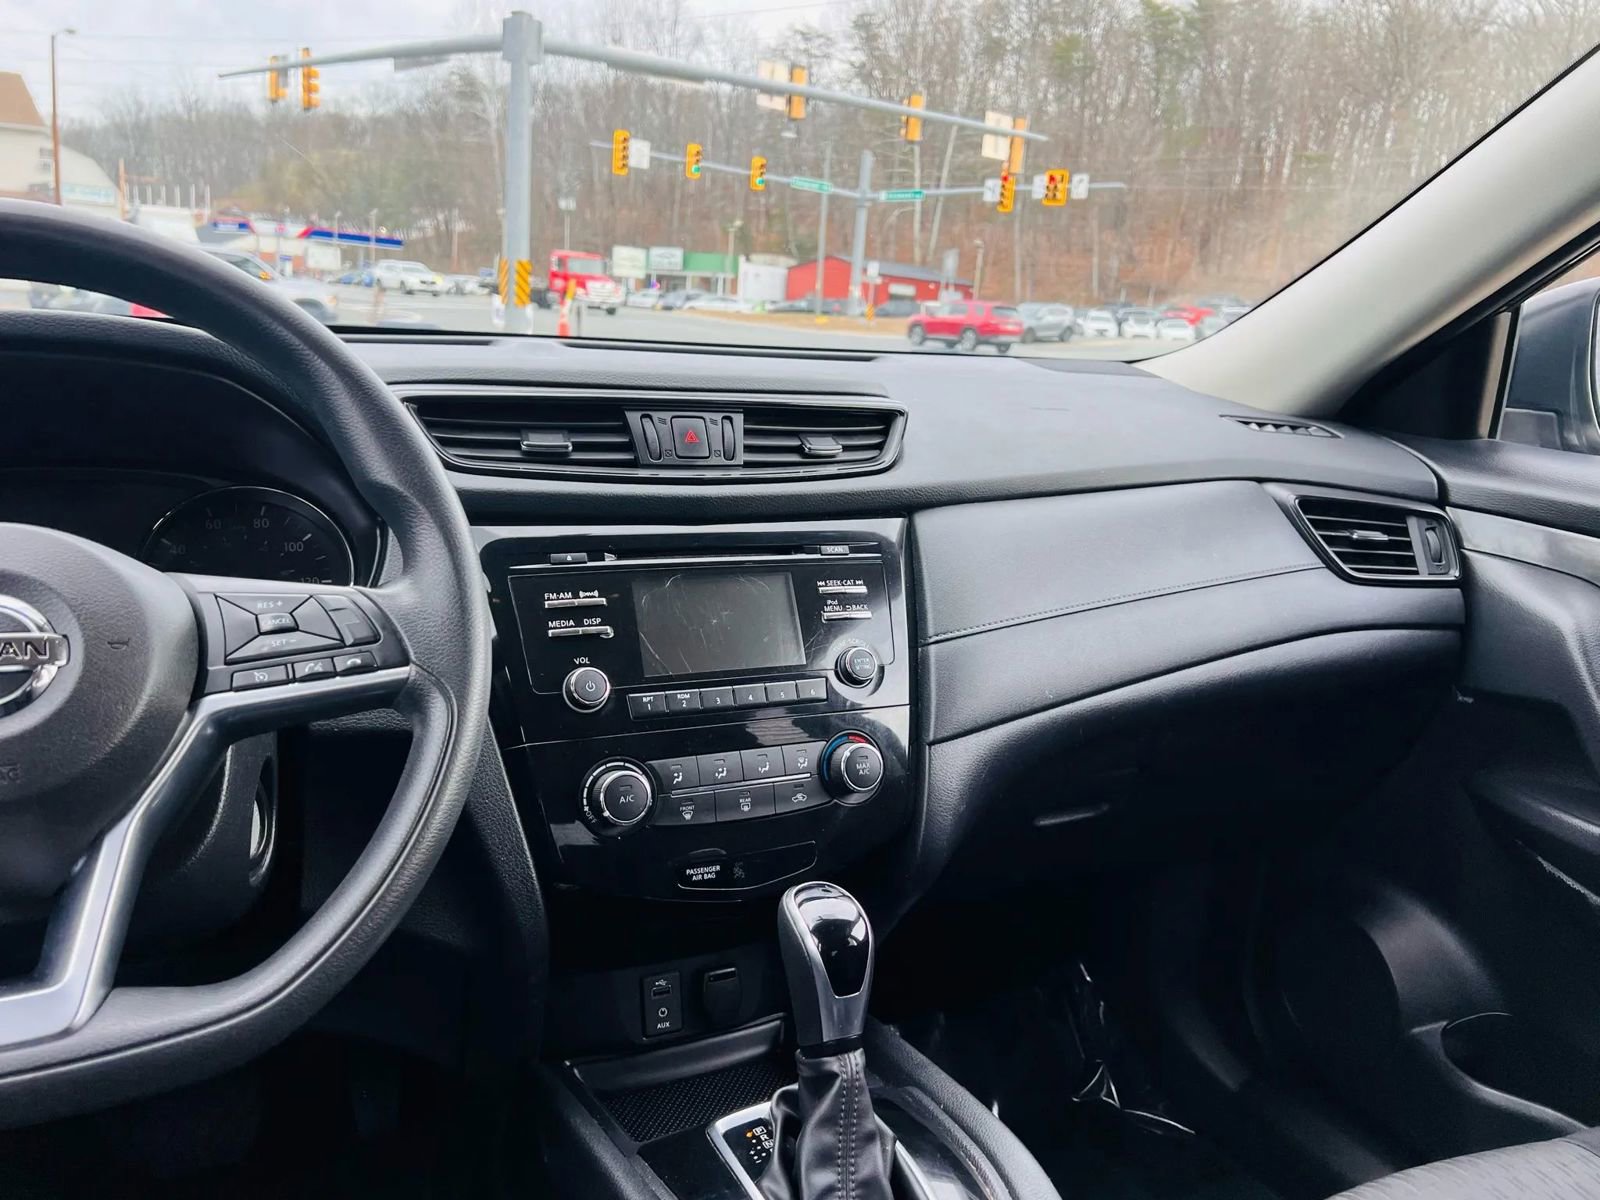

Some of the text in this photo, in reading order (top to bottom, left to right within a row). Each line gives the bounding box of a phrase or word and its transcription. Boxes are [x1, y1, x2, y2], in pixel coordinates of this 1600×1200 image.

[252, 518, 270, 529] 80
[284, 542, 304, 552] 100
[826, 545, 844, 553] SCAN
[548, 617, 602, 628] MEDIA DISP
[573, 656, 591, 665] VOL
[858, 768, 870, 776] A/C
[619, 794, 635, 804] A/C
[585, 810, 598, 824] OFF
[686, 865, 721, 876] PASSENGER
[703, 872, 716, 880] BAG
[656, 1021, 670, 1029] AUX
